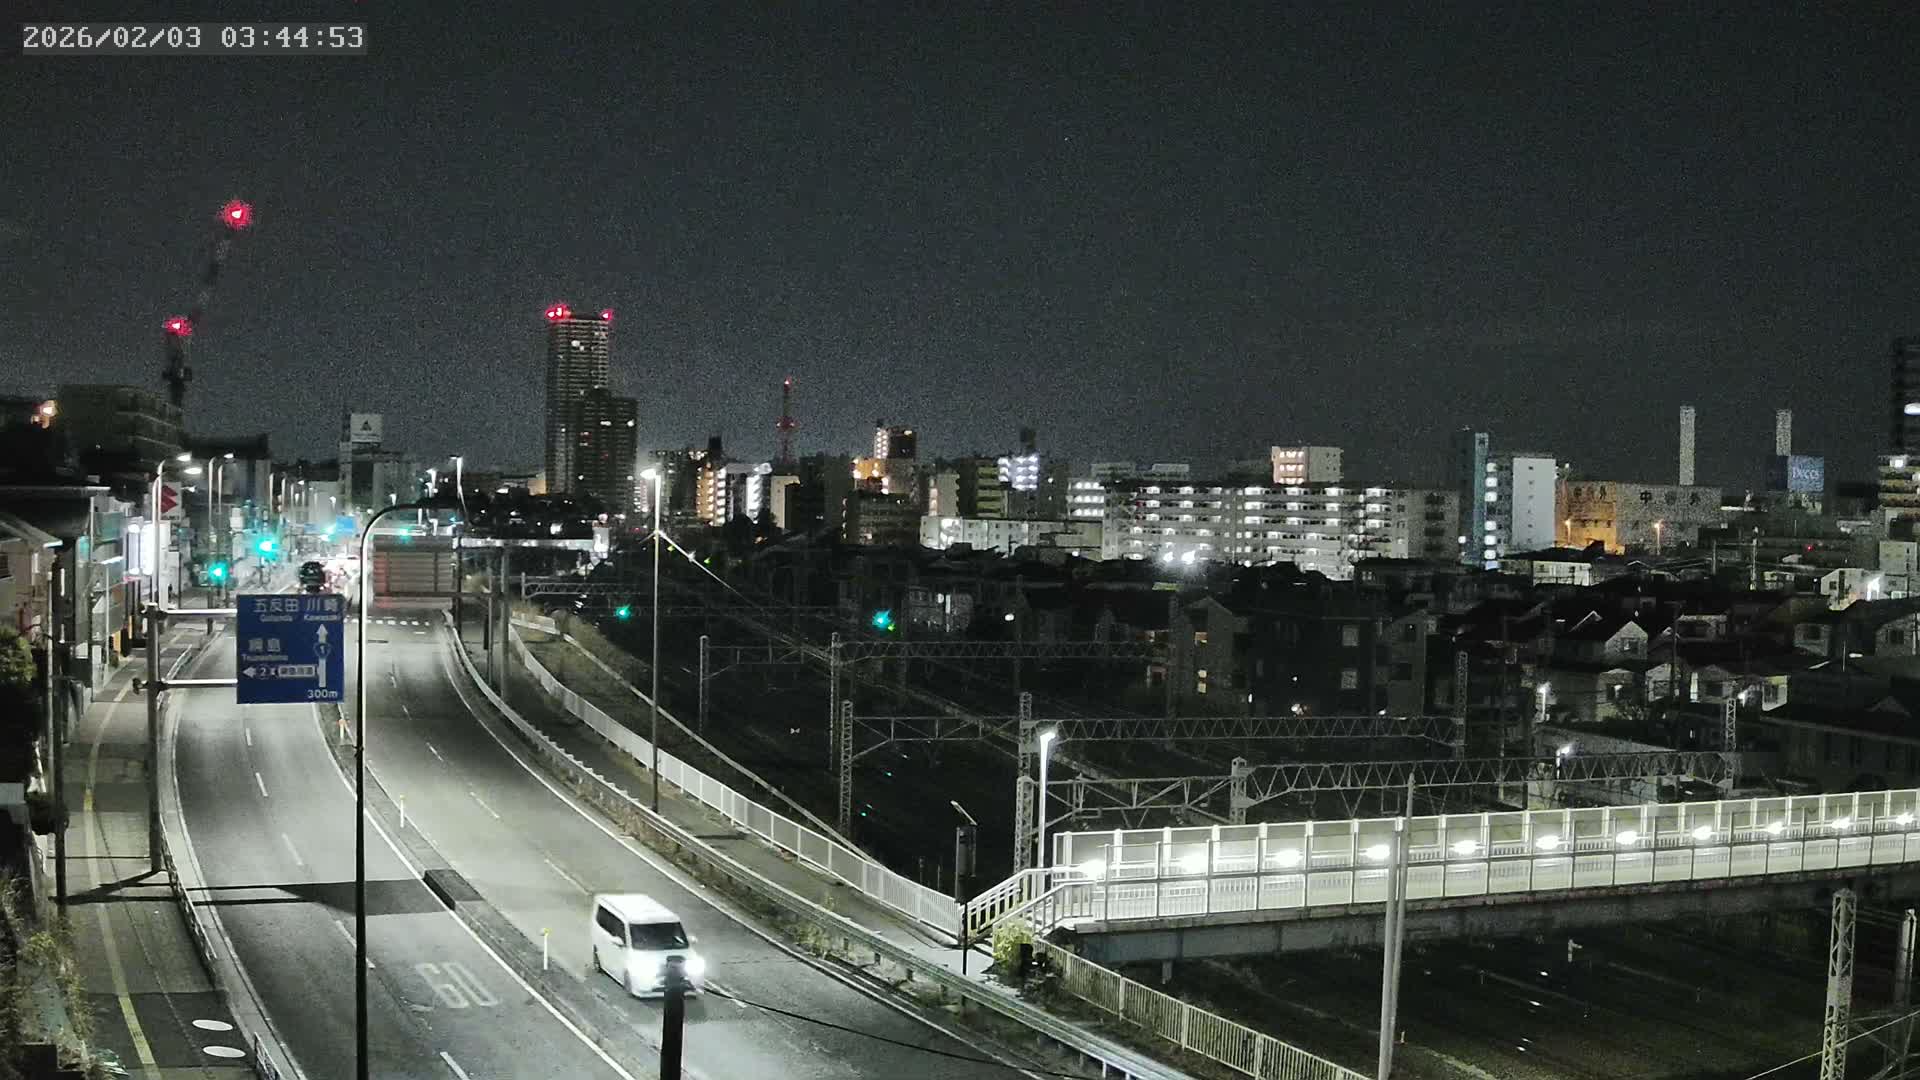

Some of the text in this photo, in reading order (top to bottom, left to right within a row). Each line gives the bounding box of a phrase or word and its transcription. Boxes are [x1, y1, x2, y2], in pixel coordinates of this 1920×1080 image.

[253, 598, 299, 613] 五反田
[307, 689, 338, 699] 300m
[415, 962, 500, 1008] 60
